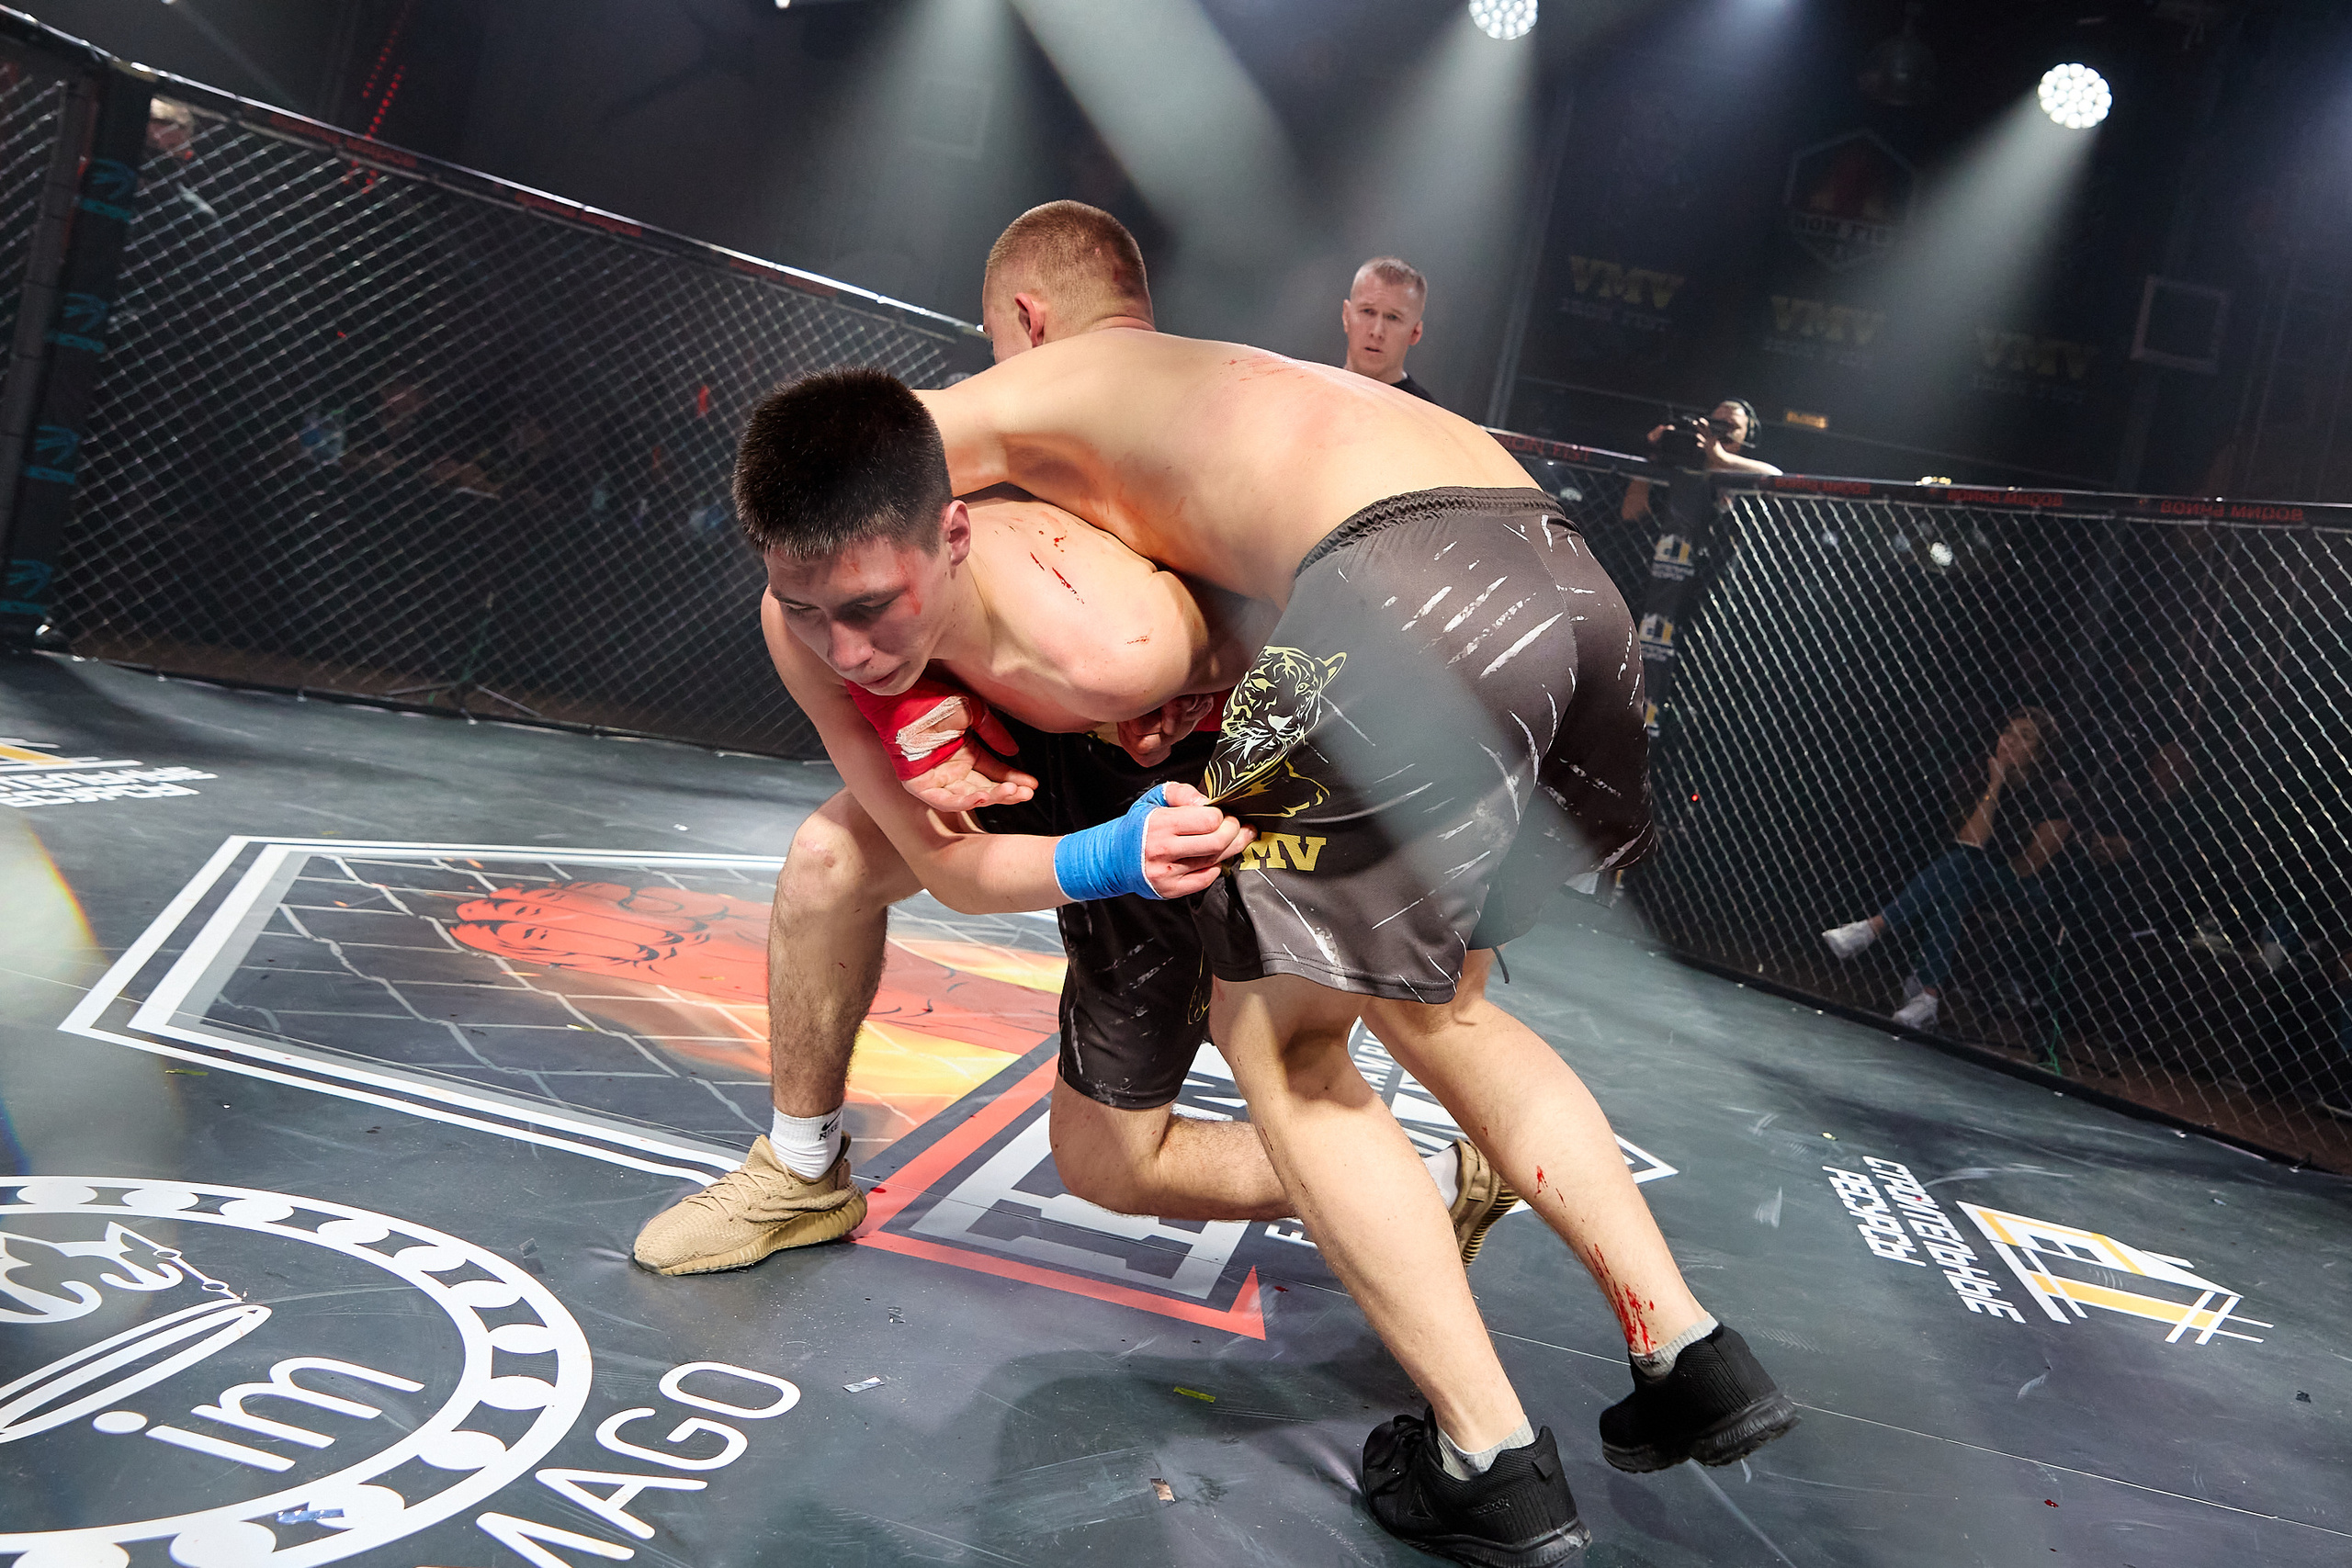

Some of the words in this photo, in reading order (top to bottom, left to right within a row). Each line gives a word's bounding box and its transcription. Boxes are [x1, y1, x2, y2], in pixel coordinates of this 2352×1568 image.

[1569, 255, 1686, 309] VMV
[1238, 830, 1328, 872] MV
[1822, 1164, 1928, 1268] РЕСУРСЫ
[1862, 1155, 2027, 1325] СТРОИТЕЛЬНЫЕ
